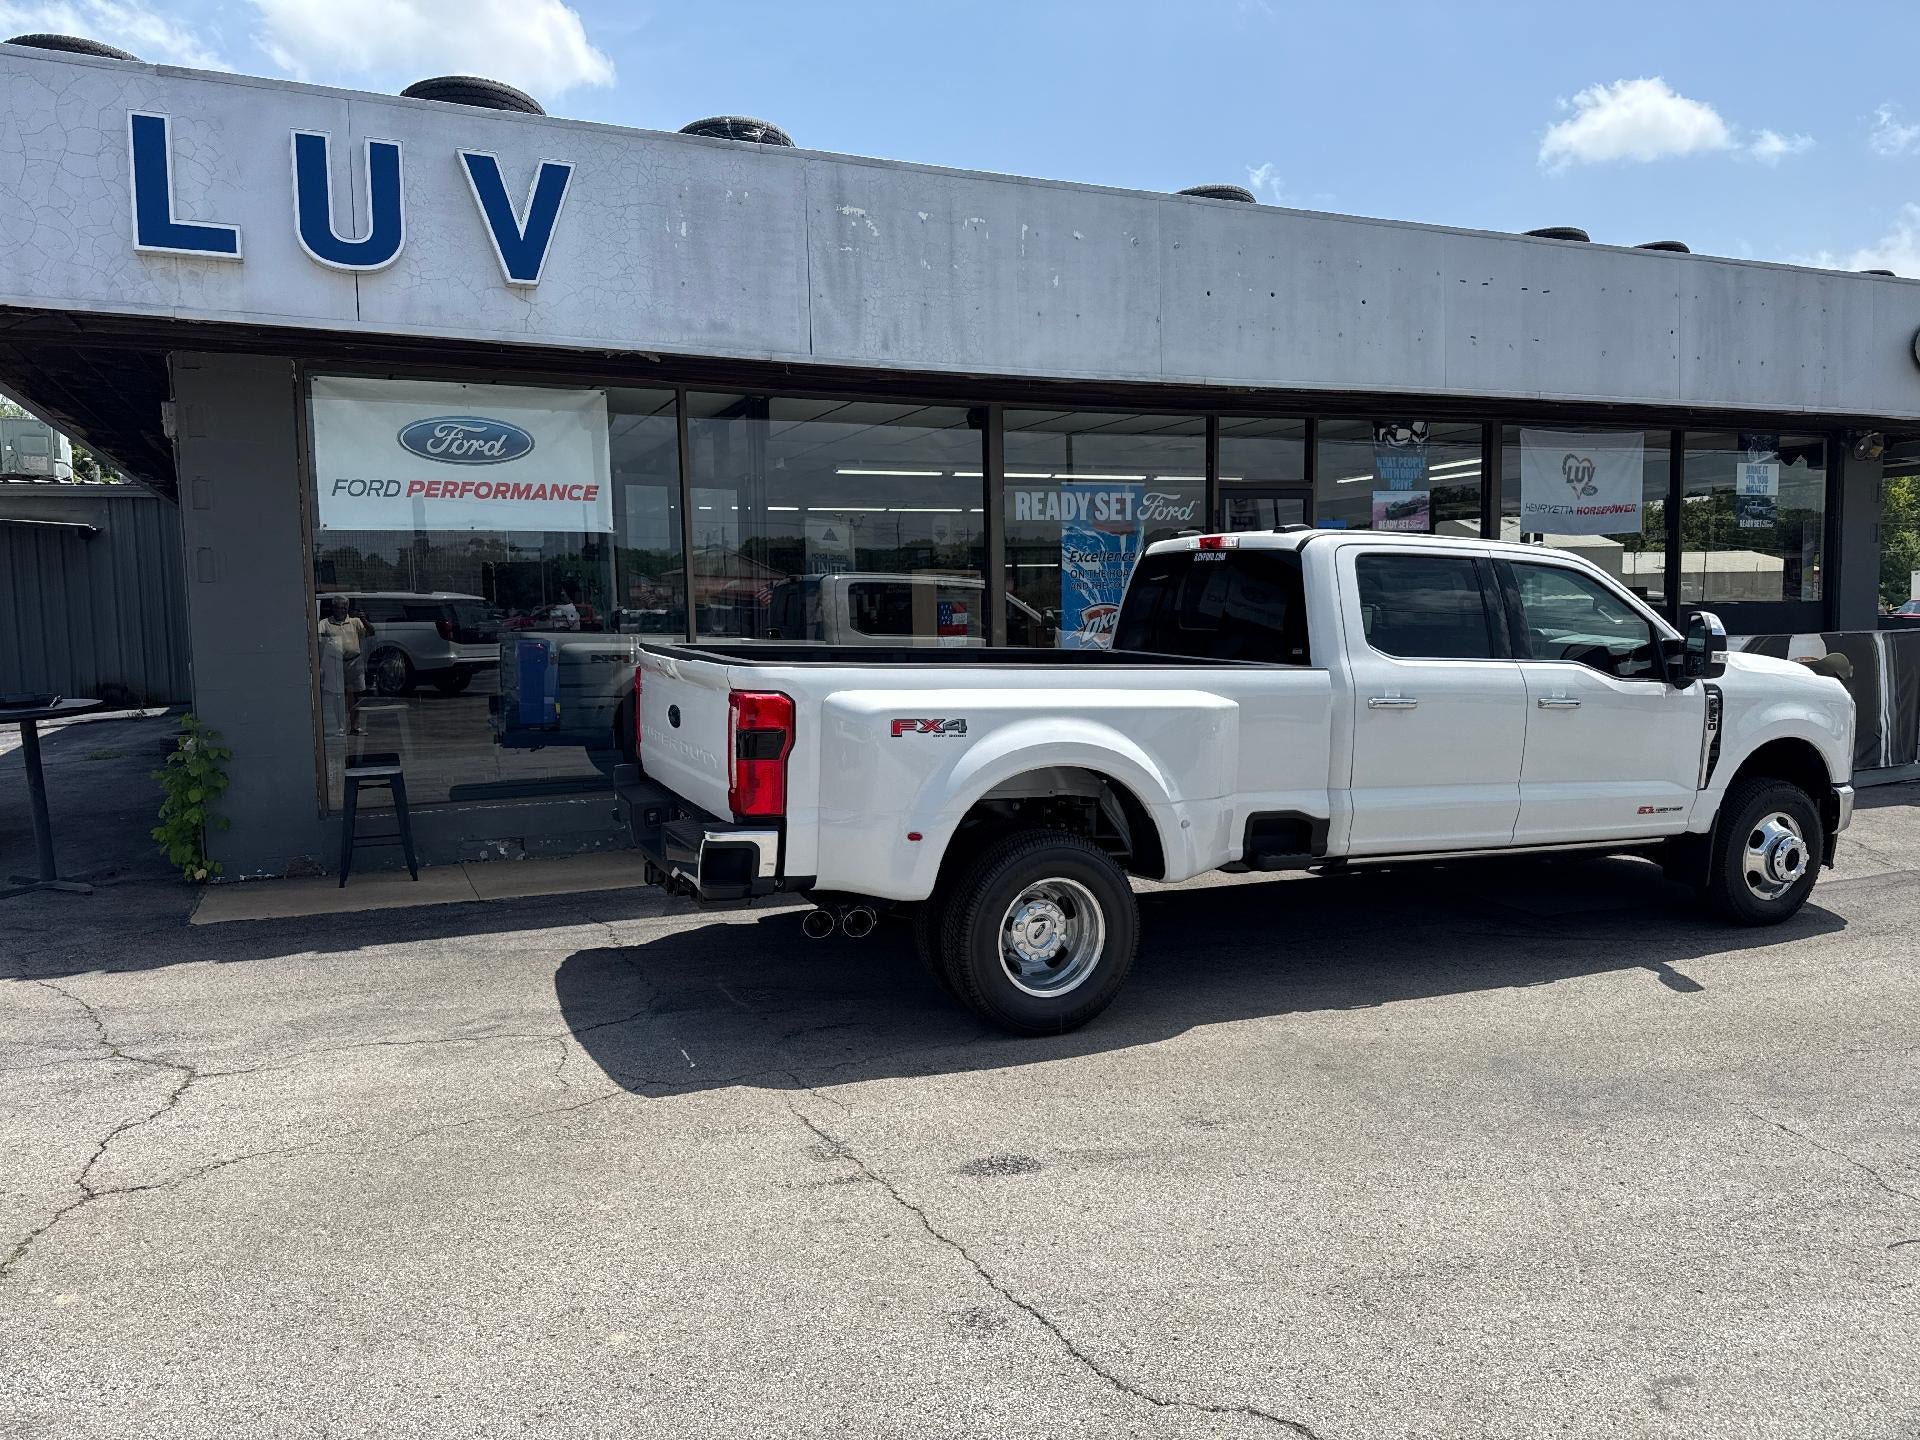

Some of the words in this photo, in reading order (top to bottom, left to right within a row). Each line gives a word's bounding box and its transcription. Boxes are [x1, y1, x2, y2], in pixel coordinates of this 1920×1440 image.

[127, 109, 577, 289] LUV
[426, 423, 506, 456] Ford
[1376, 456, 1397, 468] WHAT
[1566, 466, 1596, 483] LUV
[331, 478, 402, 498] FORD
[406, 480, 600, 502] PERFORMANCE
[1015, 491, 1090, 521] READY
[1095, 491, 1136, 521] SET
[1137, 492, 1196, 521] Ford
[1525, 502, 1574, 515] HENRYETTA
[1576, 503, 1637, 516] HORSEPOWER
[1378, 520, 1399, 529] READY
[1400, 520, 1410, 529] SET
[1740, 519, 1753, 528] READY
[1754, 519, 1762, 528] SET
[1070, 550, 1135, 563] Excellence
[1071, 570, 1085, 579] ON
[1088, 570, 1106, 579] THE
[1110, 569, 1130, 579] ROA
[1072, 582, 1089, 591] AND
[1091, 582, 1108, 591] THE
[891, 718, 968, 738] FX4
